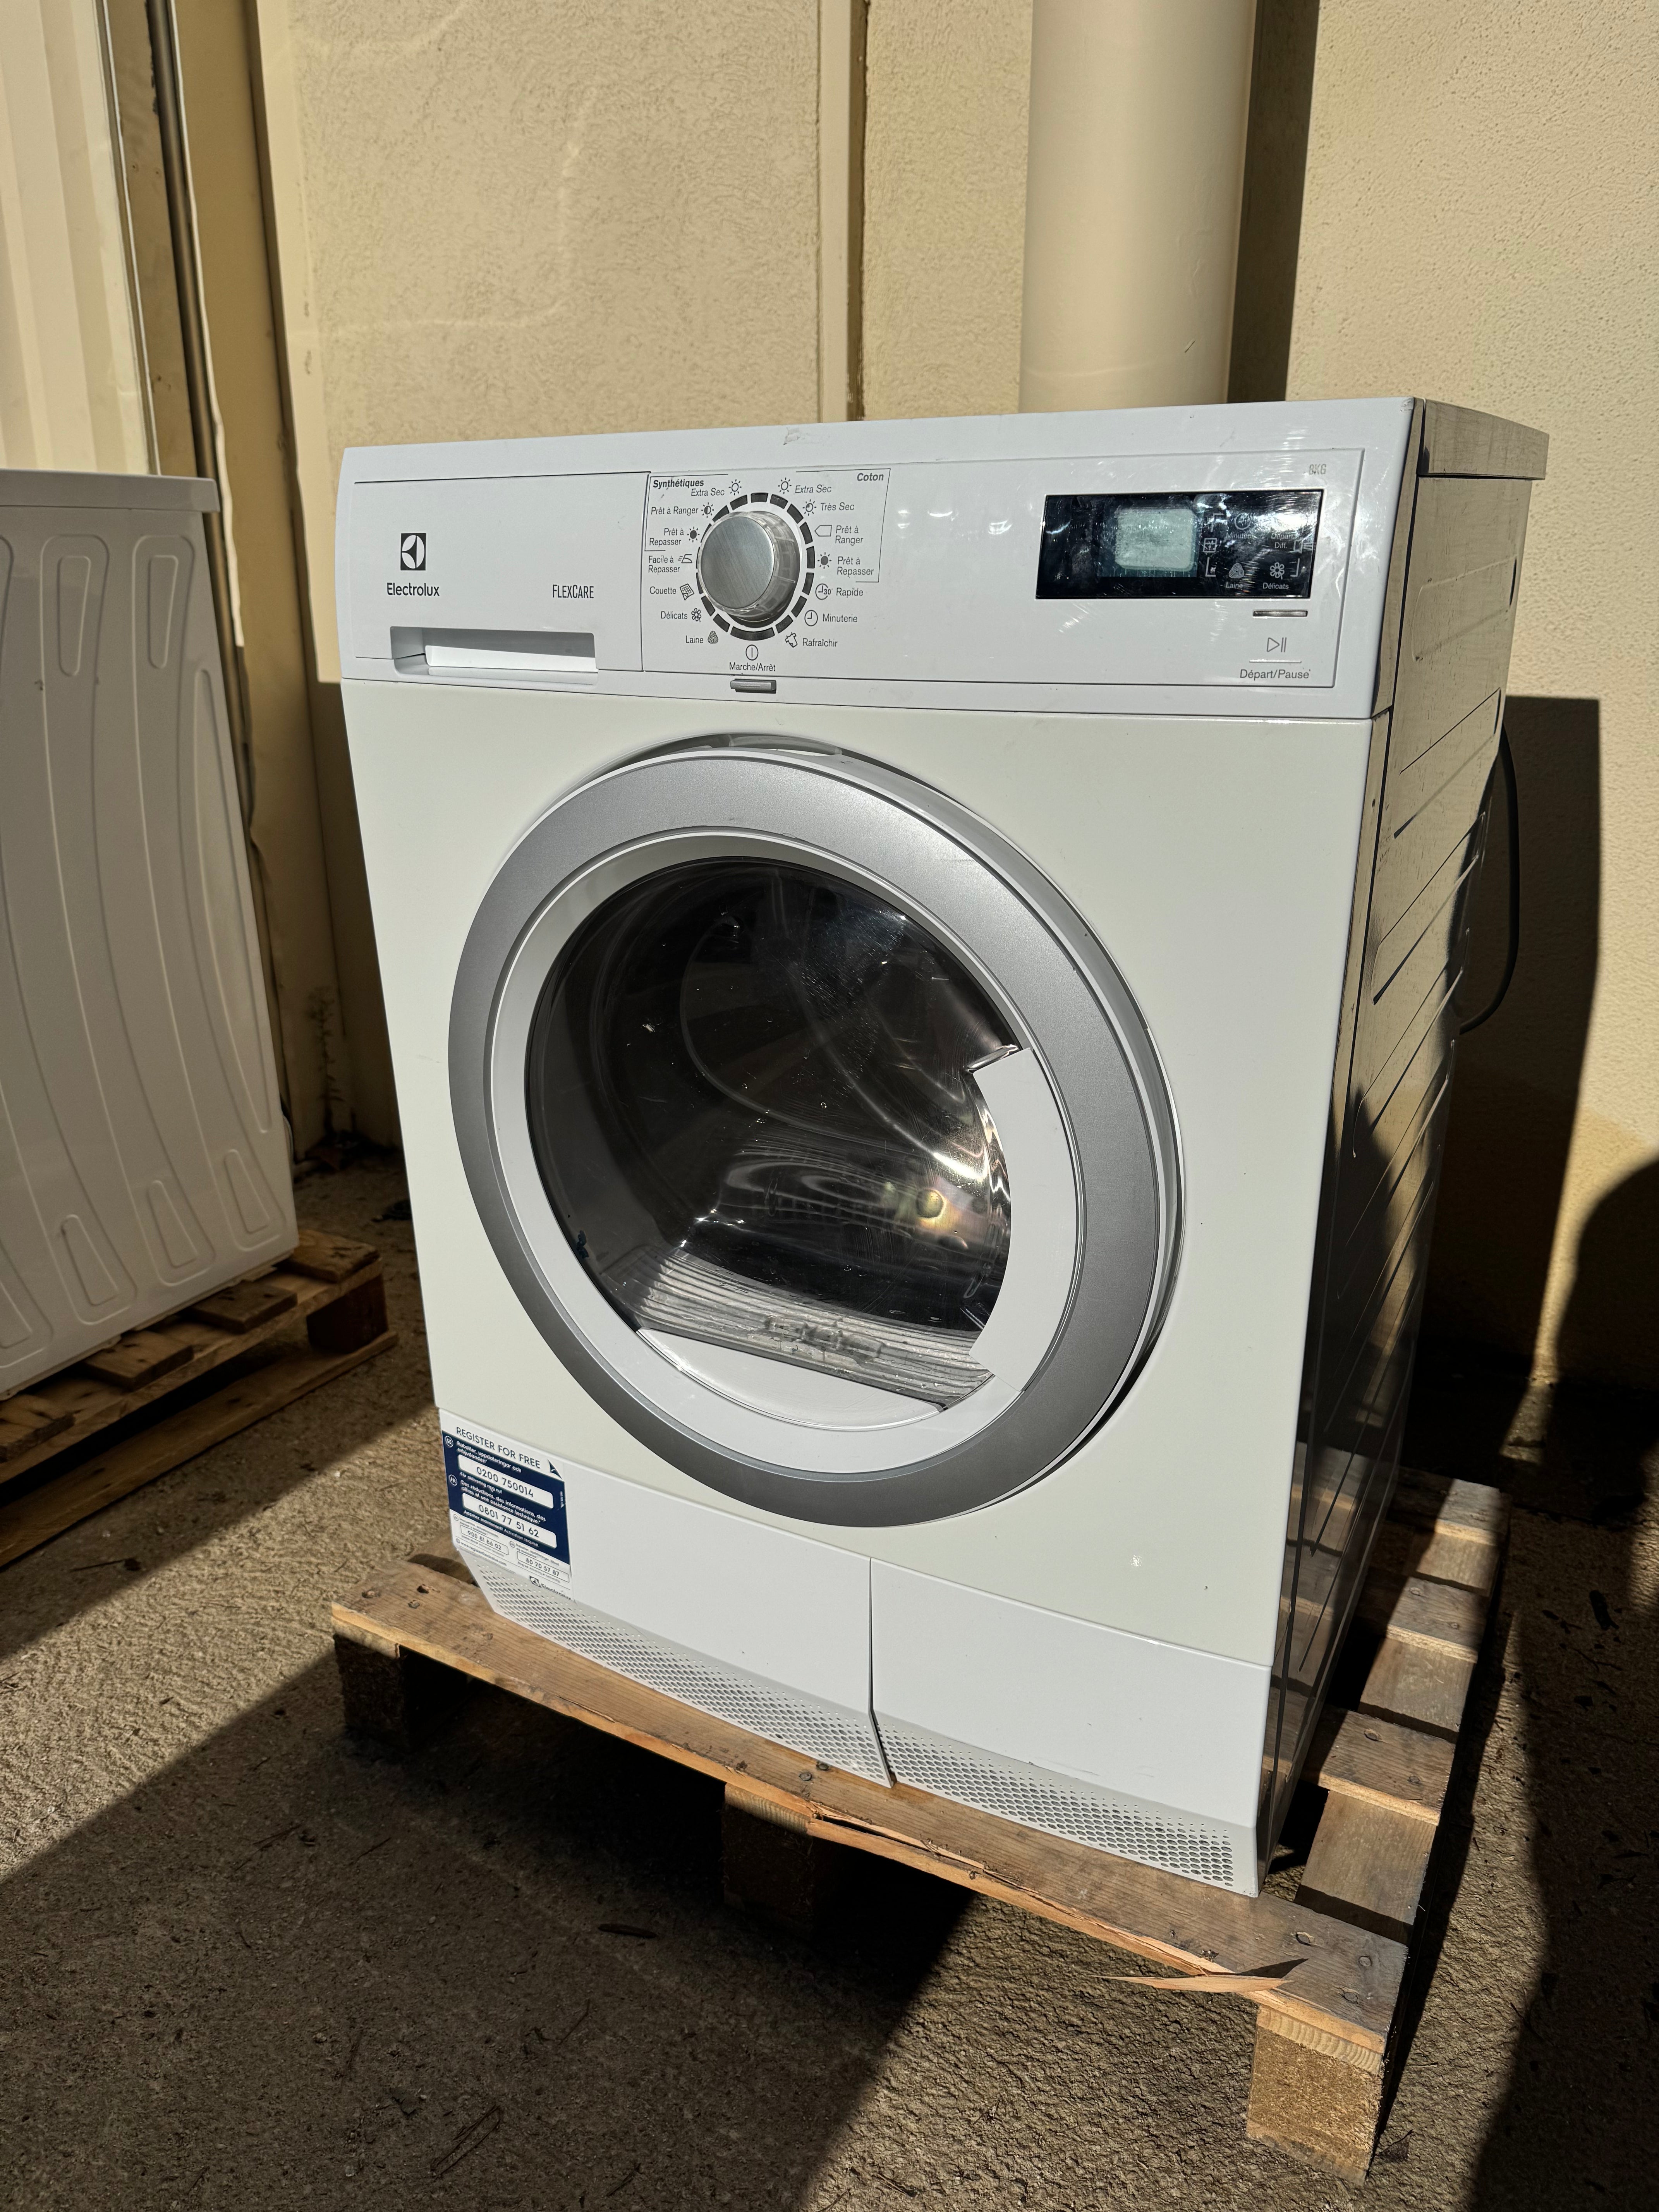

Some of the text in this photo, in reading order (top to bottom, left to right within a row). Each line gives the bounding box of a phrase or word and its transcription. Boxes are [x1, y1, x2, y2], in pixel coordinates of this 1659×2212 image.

[857, 472, 884, 482] Coton
[653, 479, 704, 489] Synthétiques
[795, 484, 832, 494] Extra Sec
[691, 488, 725, 496] Extra Sec
[651, 507, 665, 515] Prêt
[673, 506, 699, 516] Ranger
[820, 502, 855, 511] Très Sec
[664, 527, 678, 536] Prêt
[836, 525, 859, 534] Prêt à
[649, 538, 682, 548] Repasser
[835, 535, 864, 546] Ranger
[648, 555, 668, 563] Facile
[837, 556, 860, 565] Prêt à
[648, 565, 680, 575] Repasser
[837, 566, 874, 577] Repasser
[386, 582, 440, 597] Electrolux
[551, 584, 595, 599] FLEXCARE
[649, 586, 677, 594] Couette
[836, 587, 864, 599] Rapide
[660, 611, 688, 620] Délicats
[822, 613, 858, 623] Minuterie
[685, 635, 704, 644] Laine
[802, 638, 838, 647] Rafraîchir
[729, 661, 776, 672] Marche/Arrêt
[1240, 668, 1309, 681] Départ/Pause
[456, 1426, 540, 1470] REGISTER FOR FREE
[478, 1450, 511, 1469] uppdateringar
[512, 1464, 521, 1473] och
[477, 1466, 533, 1498] 0200 750014
[461, 1480, 469, 1488] Des
[470, 1484, 495, 1500] réductions,
[505, 1499, 536, 1518] informations,
[537, 1514, 546, 1522] des
[490, 1498, 514, 1513] assistance
[479, 1504, 539, 1538] 0801 77 51 62
[467, 1530, 477, 1539] 900
[495, 1542, 501, 1551] 02
[535, 1561, 542, 1569] 70
[544, 1565, 551, 1573] 57
